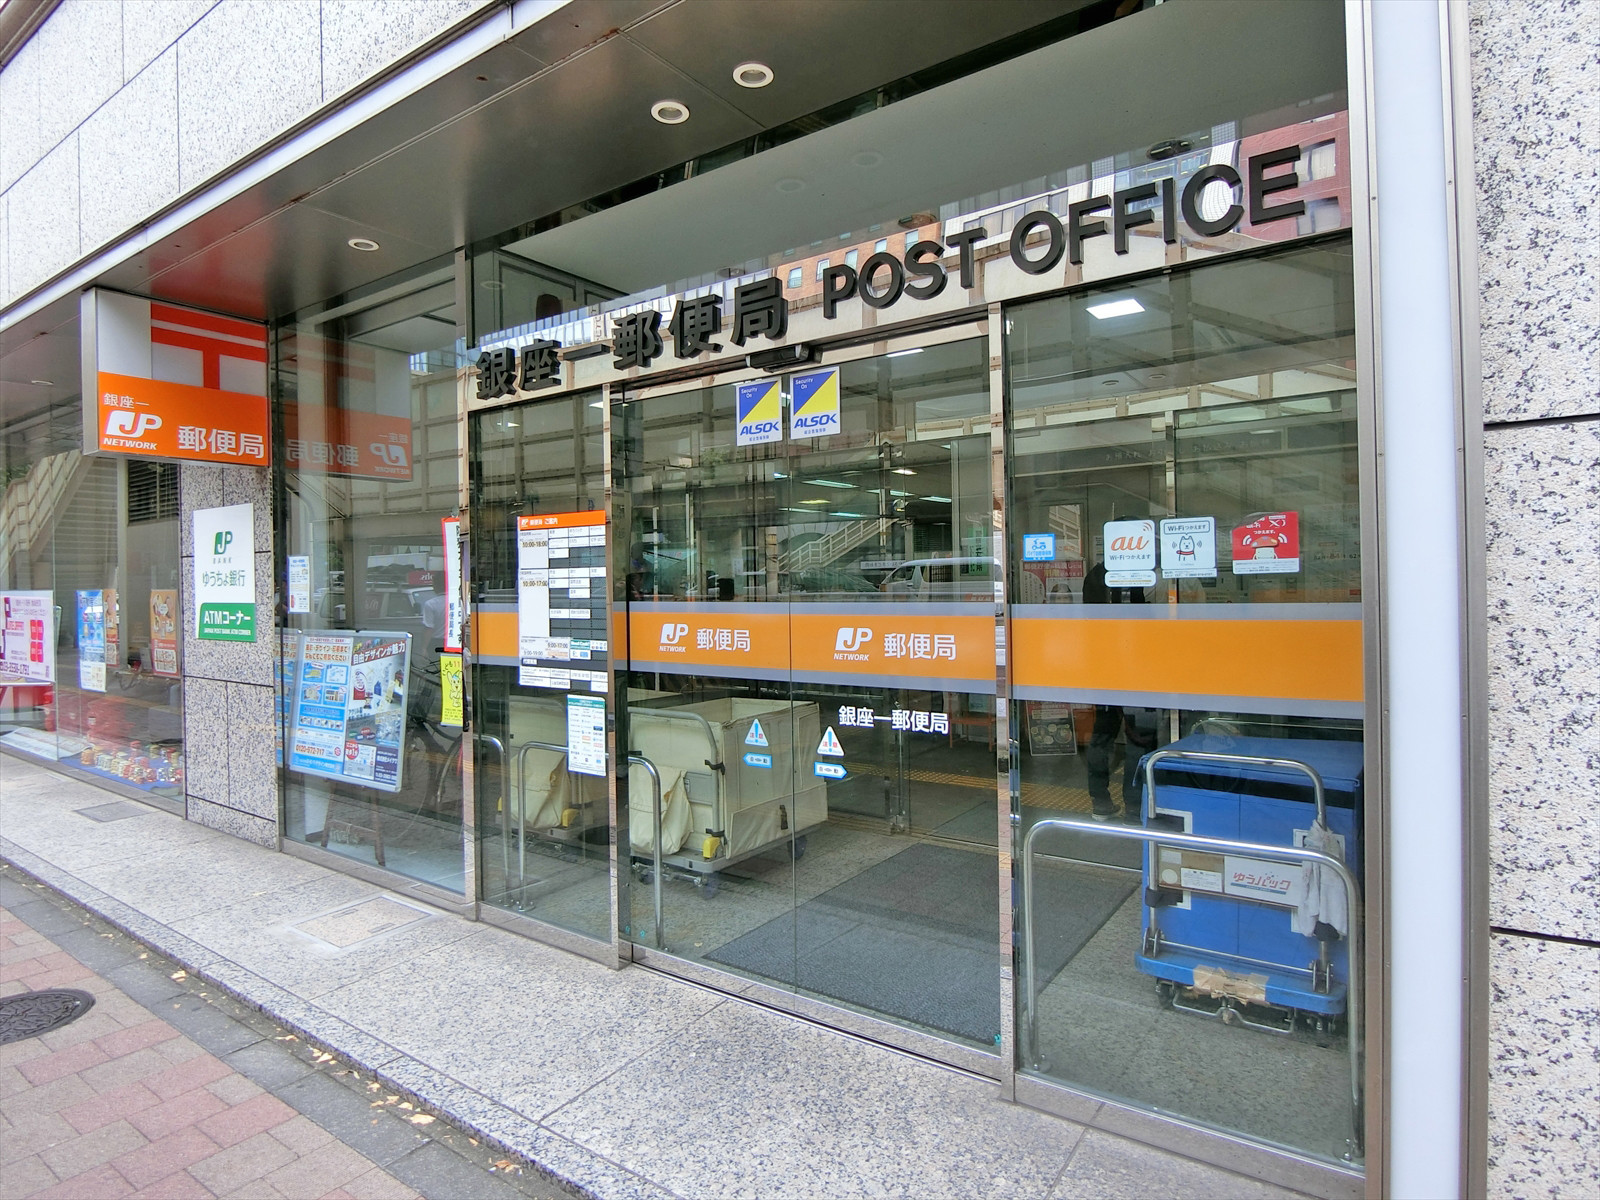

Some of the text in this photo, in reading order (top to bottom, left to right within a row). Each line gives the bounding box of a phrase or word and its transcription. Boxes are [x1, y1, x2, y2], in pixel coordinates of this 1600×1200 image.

[475, 145, 1305, 400] 銀座一郵便局 POST OFFICE
[103, 393, 150, 409] 銀座一
[105, 410, 163, 438] JP
[740, 421, 779, 436] ALSOK
[794, 413, 837, 429] ALSOK
[103, 438, 158, 450] NETWORK
[178, 425, 265, 459] 郵便局
[214, 530, 233, 555] JP
[1111, 536, 1149, 551] au
[202, 569, 246, 588] ゆうちょ銀行
[204, 610, 251, 625] ATMコーナー
[660, 623, 689, 645] JP
[696, 628, 751, 652] 郵便局
[834, 627, 873, 651] JP
[659, 645, 687, 653] NETWORK
[884, 633, 956, 660] 郵便局
[833, 653, 870, 661] NETWORK
[838, 705, 950, 735] 銀座一郵便局
[1232, 871, 1291, 890] ゆうパック
